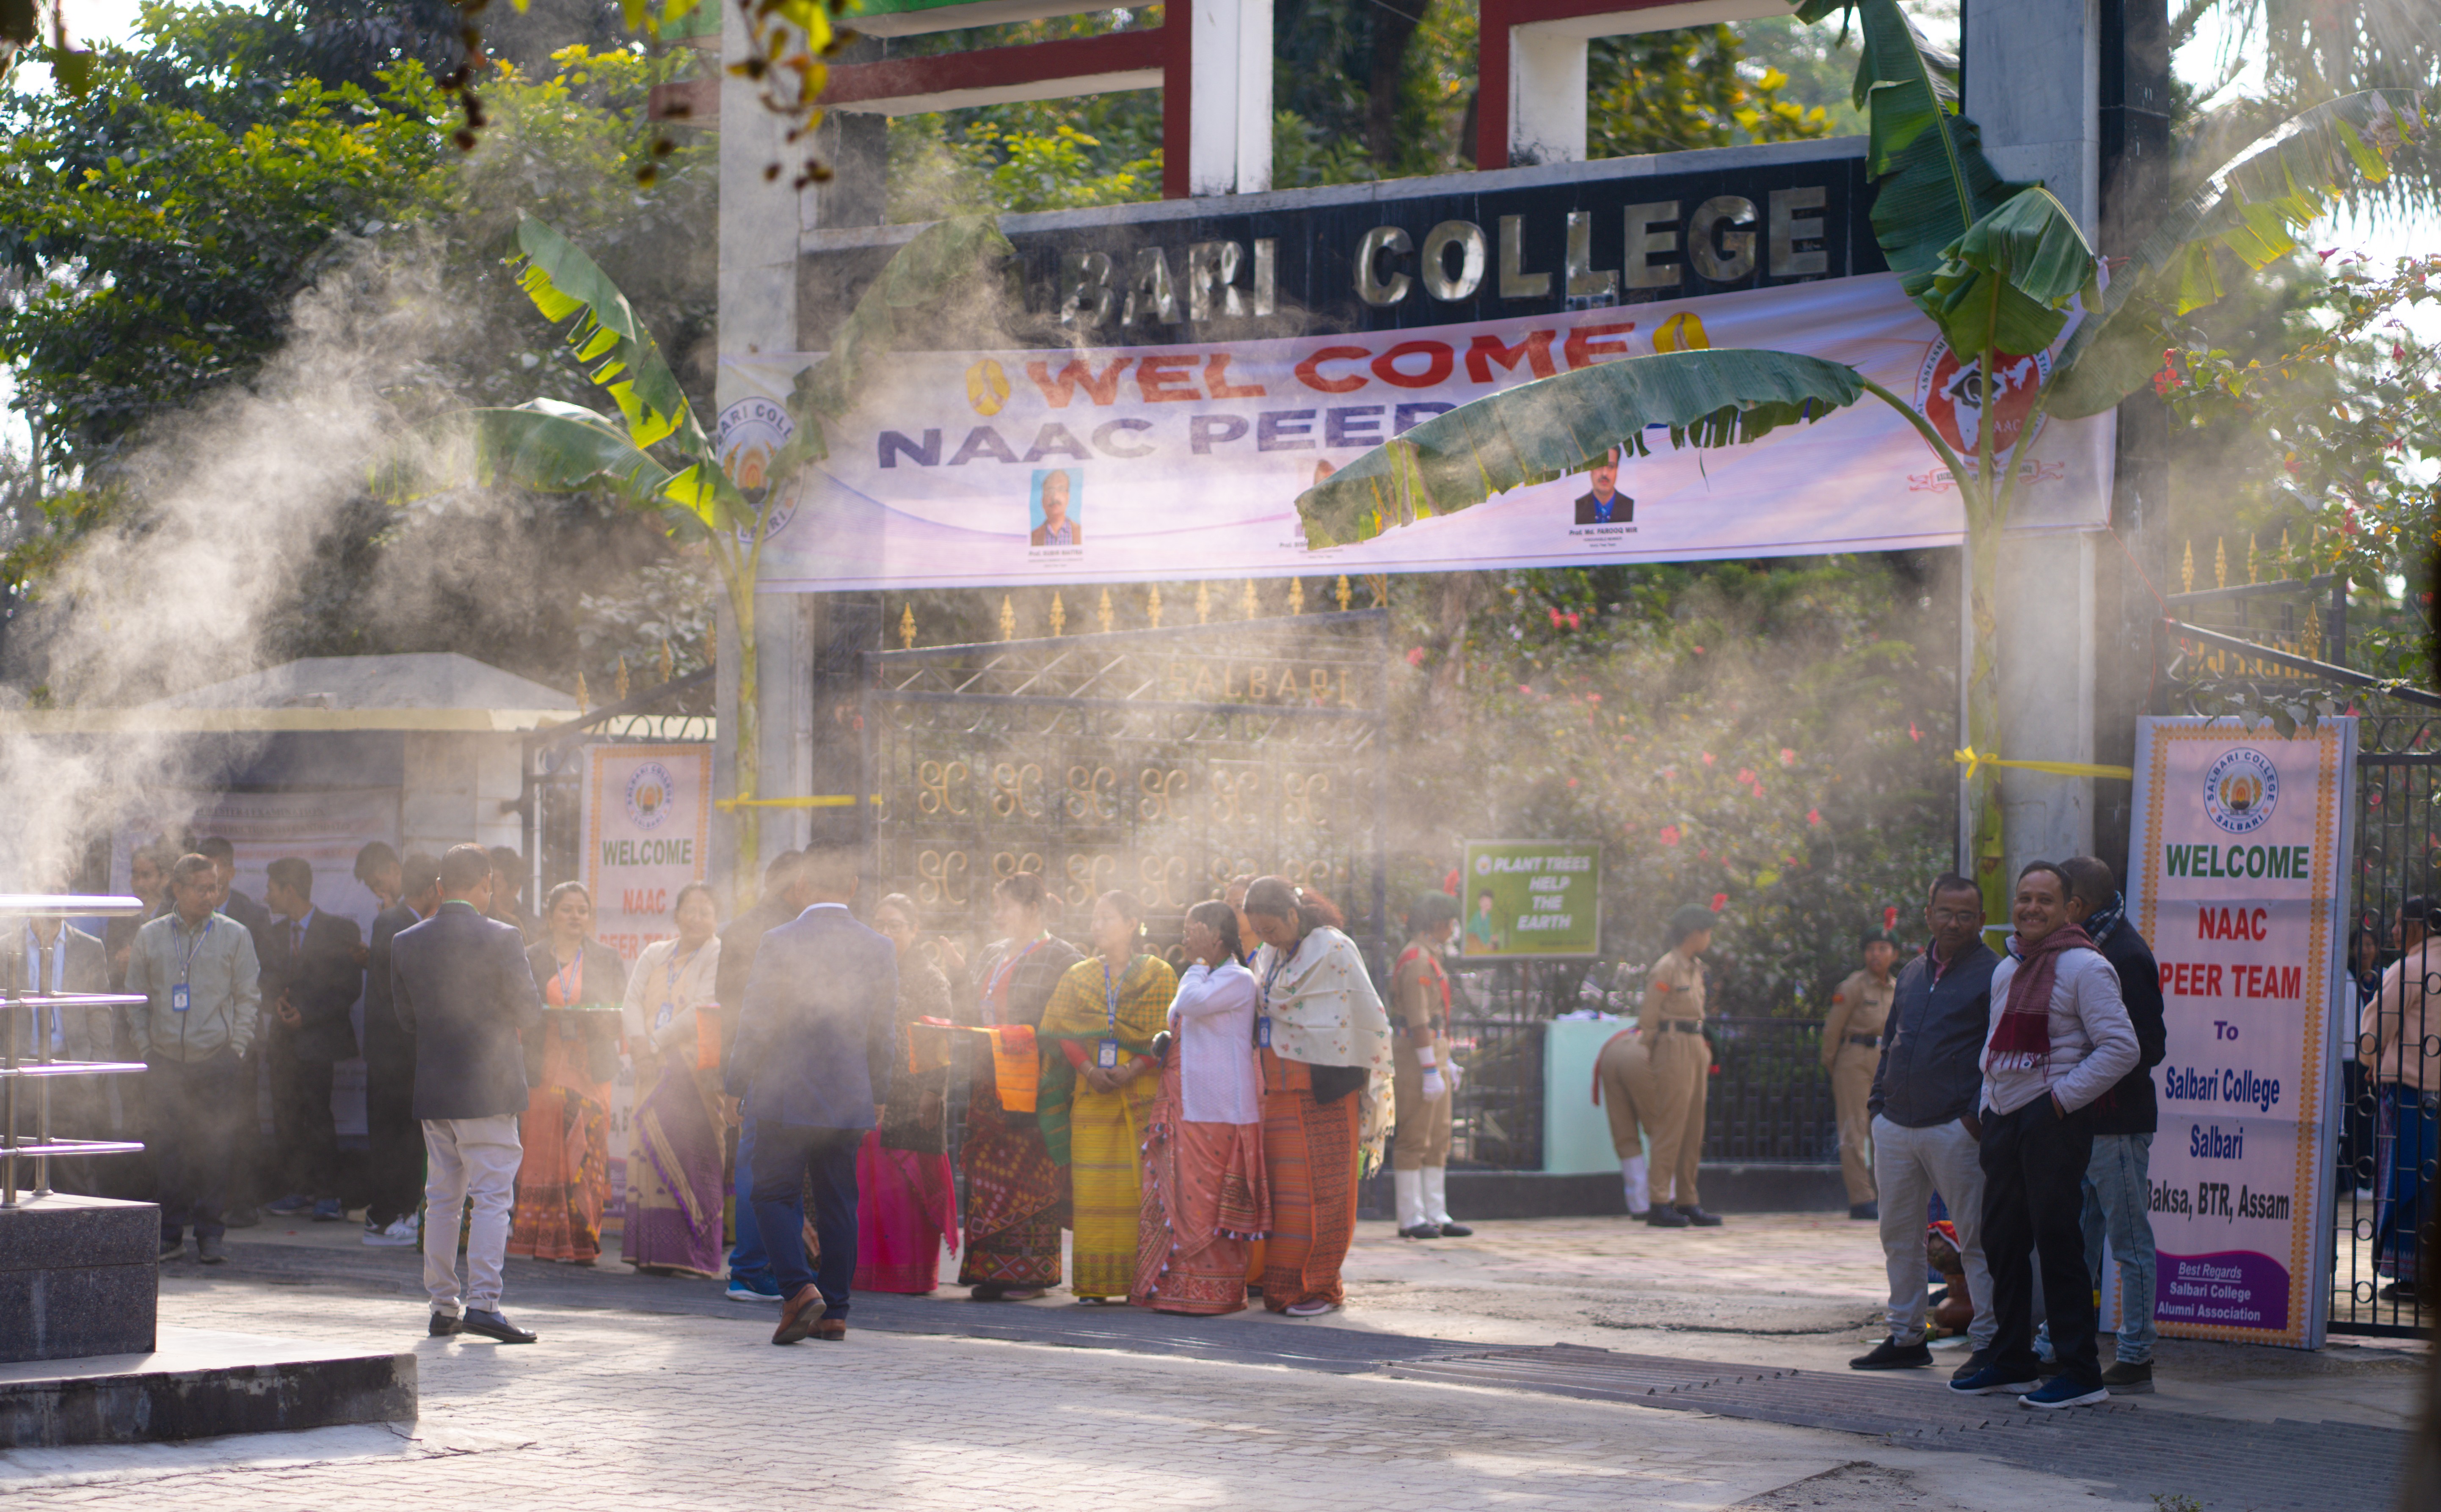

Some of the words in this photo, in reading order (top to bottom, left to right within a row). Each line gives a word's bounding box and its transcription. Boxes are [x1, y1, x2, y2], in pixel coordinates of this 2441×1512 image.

[1354, 186, 1828, 306] COLLEGE
[1026, 353, 1266, 408] WEL
[1294, 322, 1635, 393] COME
[877, 417, 1157, 468] NAAC
[1169, 662, 1351, 704] SALBARI
[2207, 752, 2238, 801] SALBARI
[2244, 752, 2276, 802] COLLEGE
[2216, 814, 2263, 831] SALBARI
[602, 838, 693, 866] WELCOME
[1493, 856, 1543, 872] PLANT
[1545, 856, 1591, 871] TREES
[2165, 844, 2310, 879] WELCOME
[1529, 876, 1571, 891] HELP
[623, 888, 667, 915] NAAC
[1532, 895, 1564, 911] THE
[1517, 914, 1572, 931] EARTH
[2198, 907, 2267, 942] NAAC
[2158, 962, 2223, 997] PEER
[2231, 965, 2302, 1000] TEAM
[2213, 1021, 2239, 1040] To
[2165, 1066, 2218, 1102] Salbari
[2222, 1069, 2280, 1112] College
[2190, 1124, 2243, 1159] Salbari
[2198, 1182, 2233, 1225] BTR,
[2237, 1184, 2289, 1220] Assam
[2178, 1261, 2201, 1276] Best
[2202, 1263, 2242, 1280] Regards
[2169, 1281, 2207, 1297] Salbari
[2210, 1283, 2251, 1303] College
[2157, 1300, 2195, 1316] Alumni
[2197, 1304, 2261, 1322] Association
